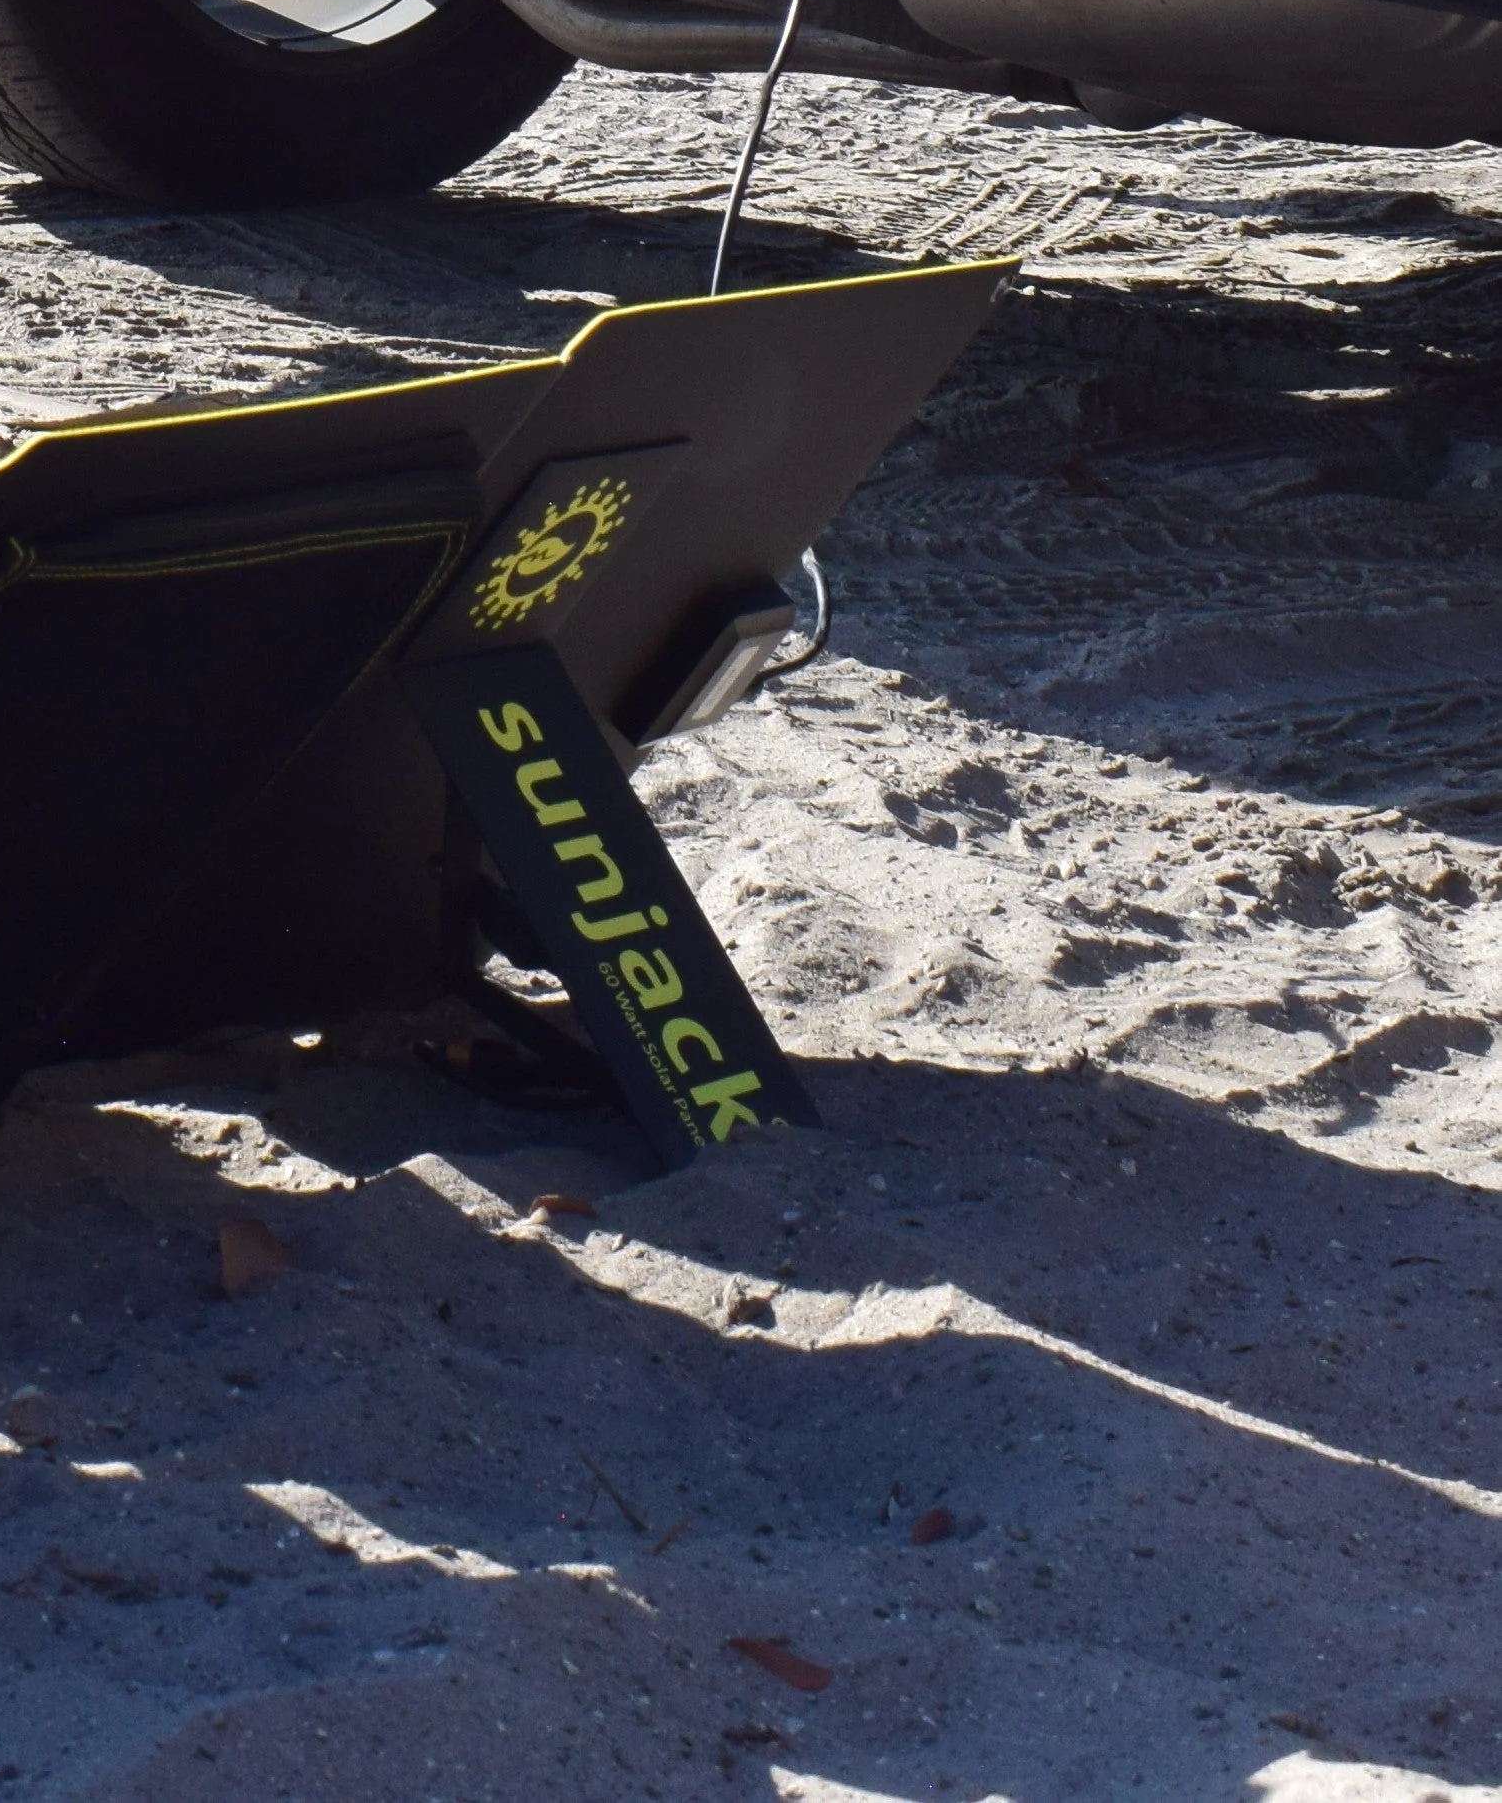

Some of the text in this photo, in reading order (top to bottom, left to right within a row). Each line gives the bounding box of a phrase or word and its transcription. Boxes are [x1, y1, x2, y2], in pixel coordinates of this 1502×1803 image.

[599, 962, 706, 1148] 60 Watt Solar Pane
